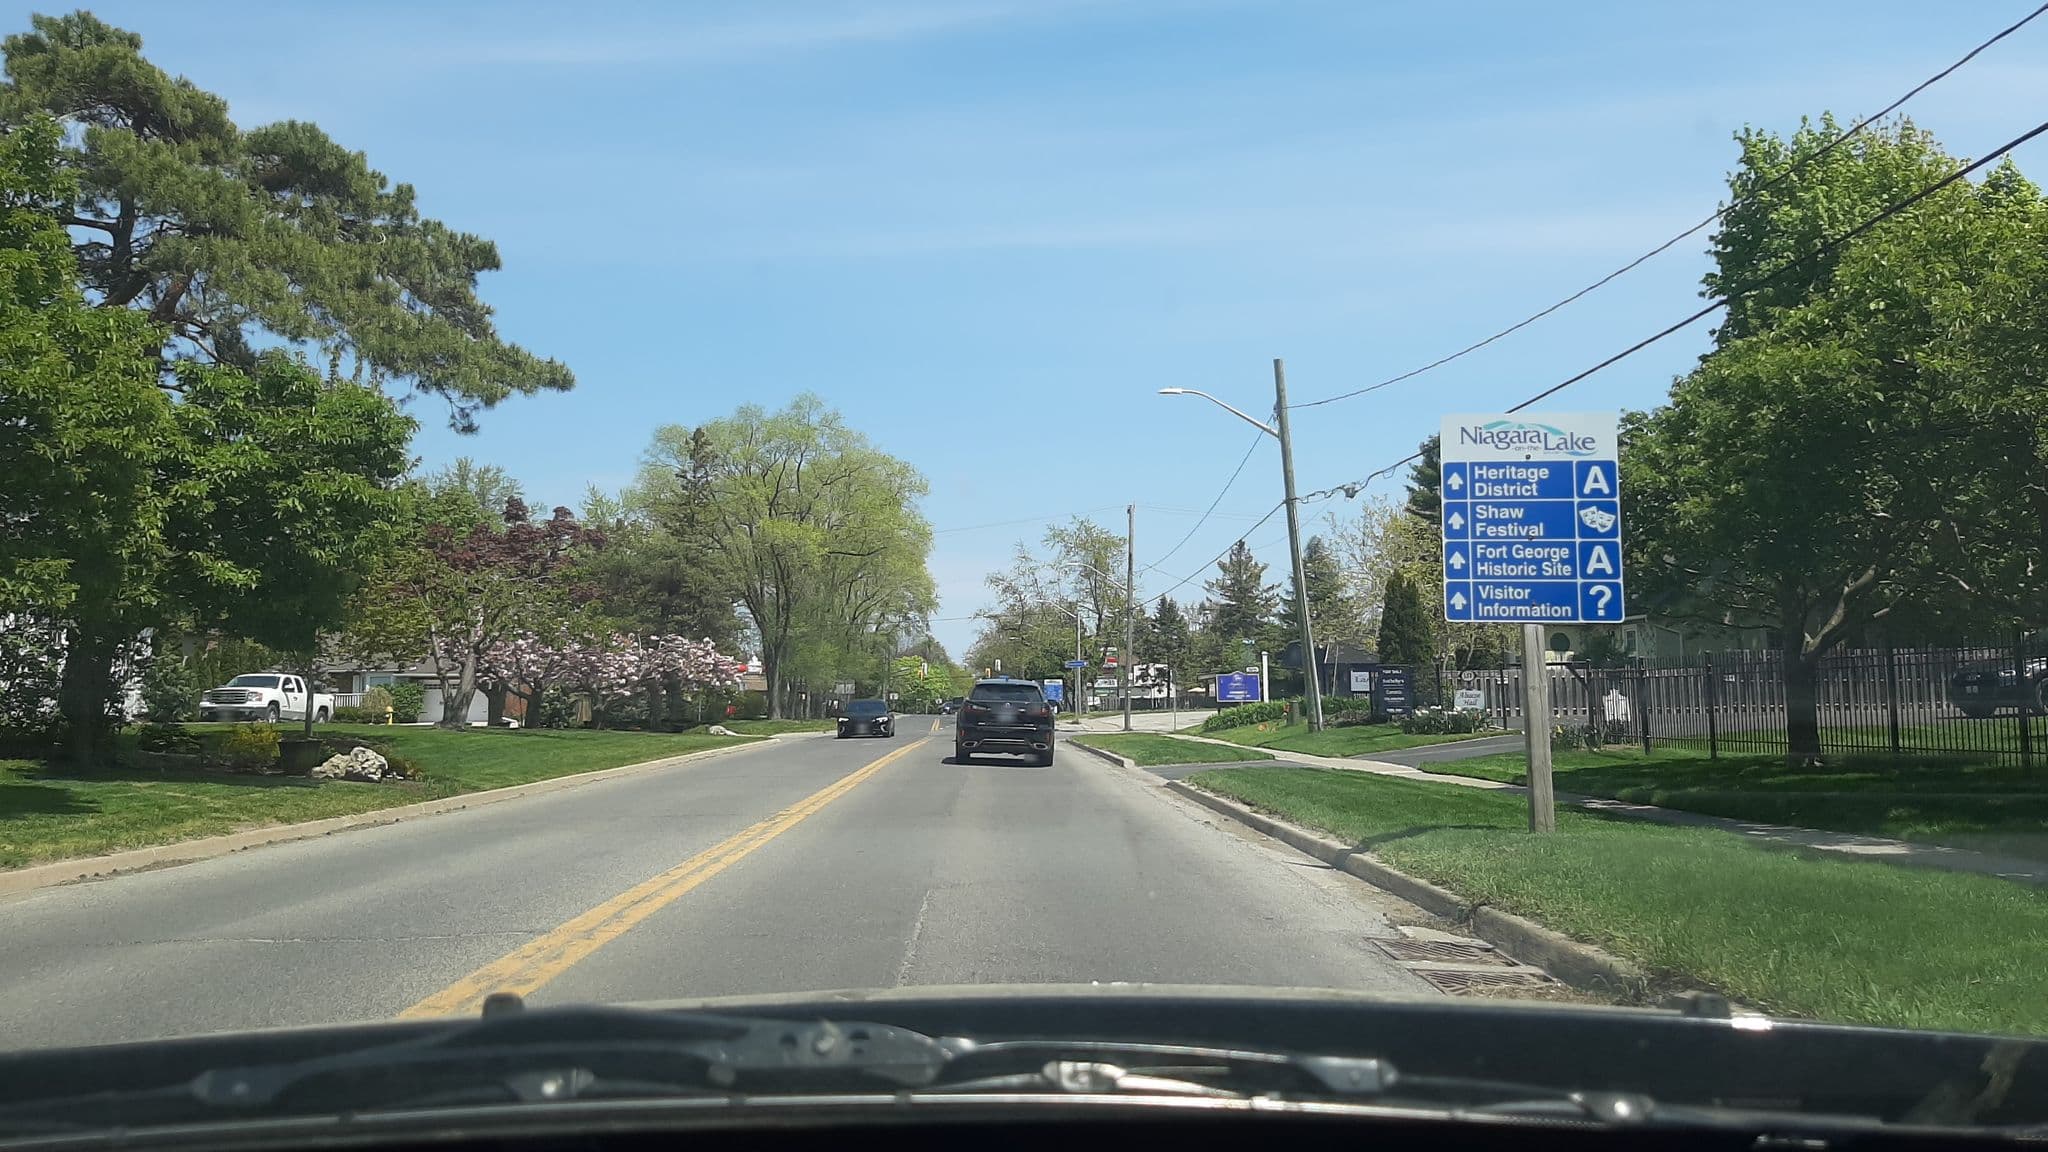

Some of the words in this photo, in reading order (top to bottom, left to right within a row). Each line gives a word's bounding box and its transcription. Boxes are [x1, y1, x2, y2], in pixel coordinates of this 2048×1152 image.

[1461, 426, 1541, 450] Niagara
[1544, 432, 1596, 451] Lake
[1474, 465, 1550, 481] Heritage
[1583, 465, 1610, 495] A
[1475, 482, 1538, 496] District
[1475, 505, 1524, 519] Shaw
[1476, 522, 1544, 537] Festival
[1476, 544, 1508, 558] Fort
[1511, 544, 1569, 562] George
[1586, 545, 1613, 575] A
[1477, 562, 1537, 576] Historic
[1541, 562, 1572, 576] Site
[1478, 585, 1531, 599] Visitor
[1478, 603, 1572, 618] Information
